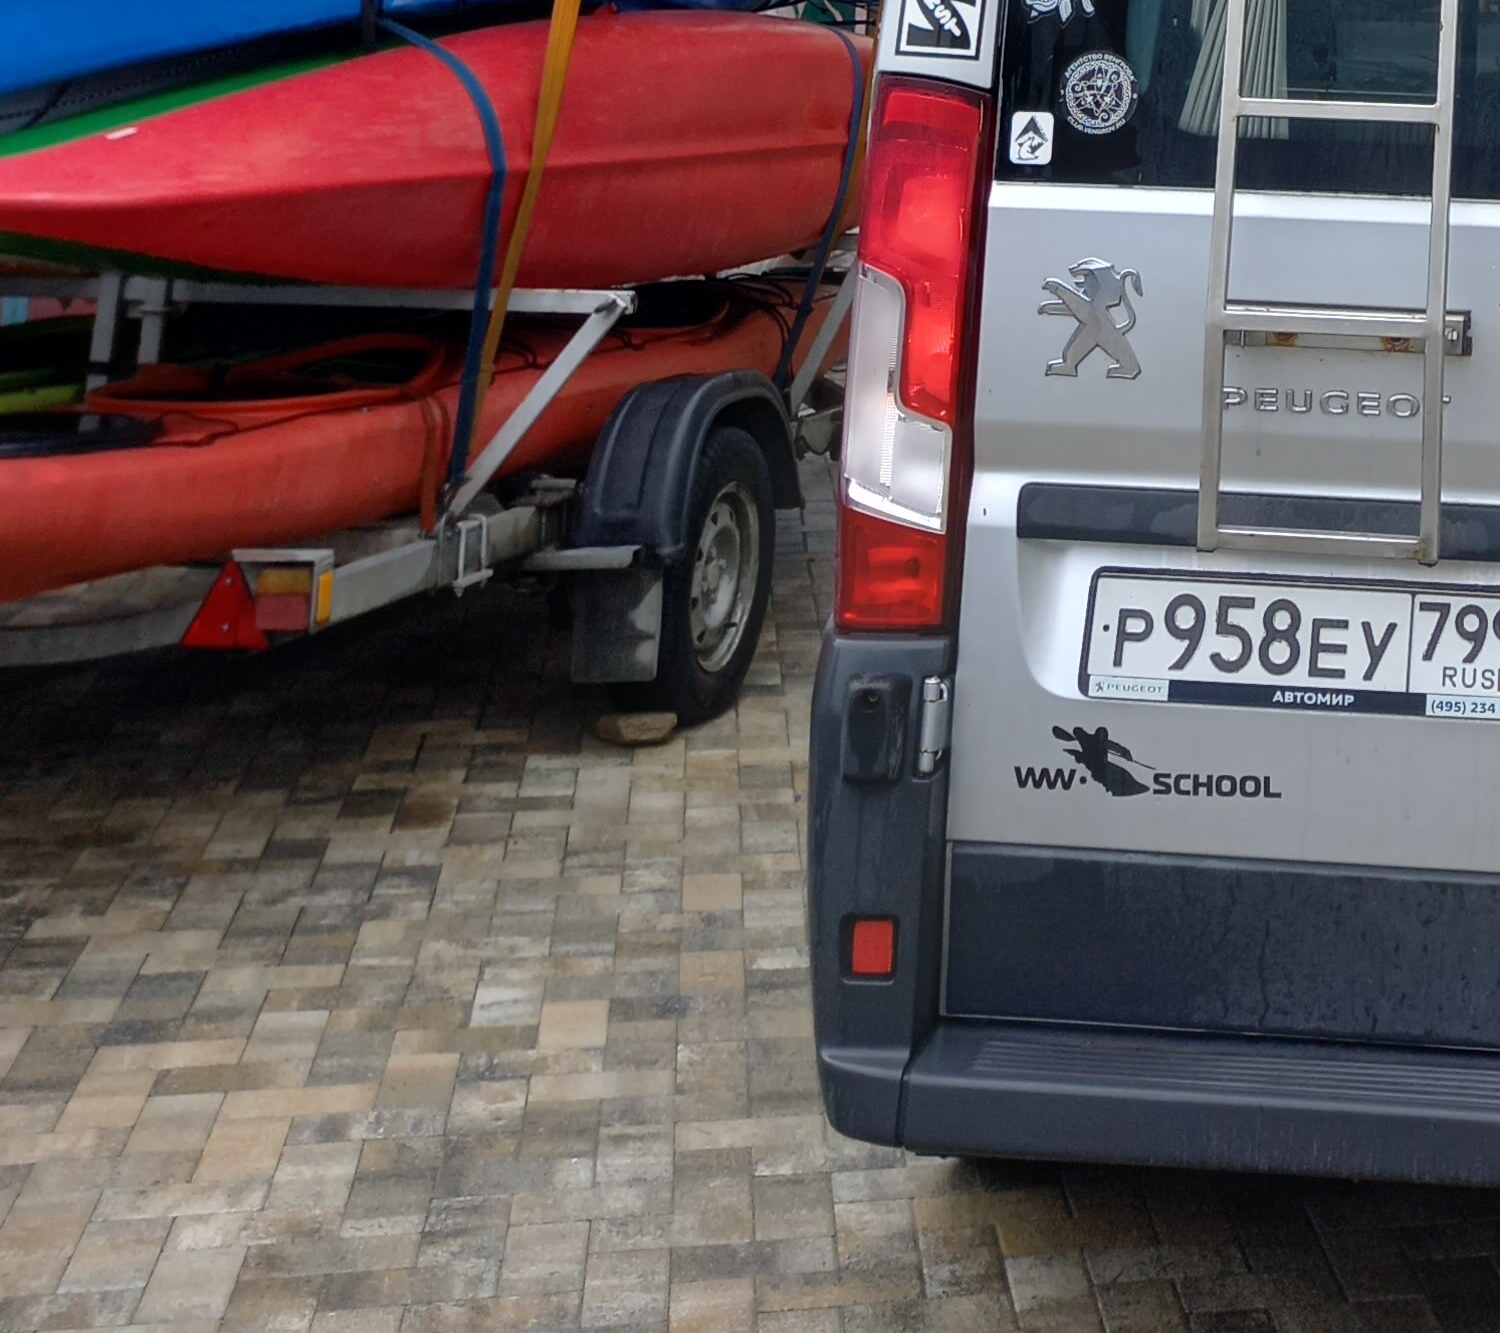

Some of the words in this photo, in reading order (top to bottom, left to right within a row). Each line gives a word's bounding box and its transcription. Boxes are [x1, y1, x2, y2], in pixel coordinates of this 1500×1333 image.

[1222, 386, 1451, 418] PEUGEO
[1106, 682, 1163, 694] PEUGEOT
[1441, 666, 1496, 690] RUS
[1272, 689, 1355, 707] АВТОМИР
[1430, 698, 1467, 715] (495)
[1470, 701, 1496, 715] 234
[1153, 772, 1282, 798] SCHOOL
